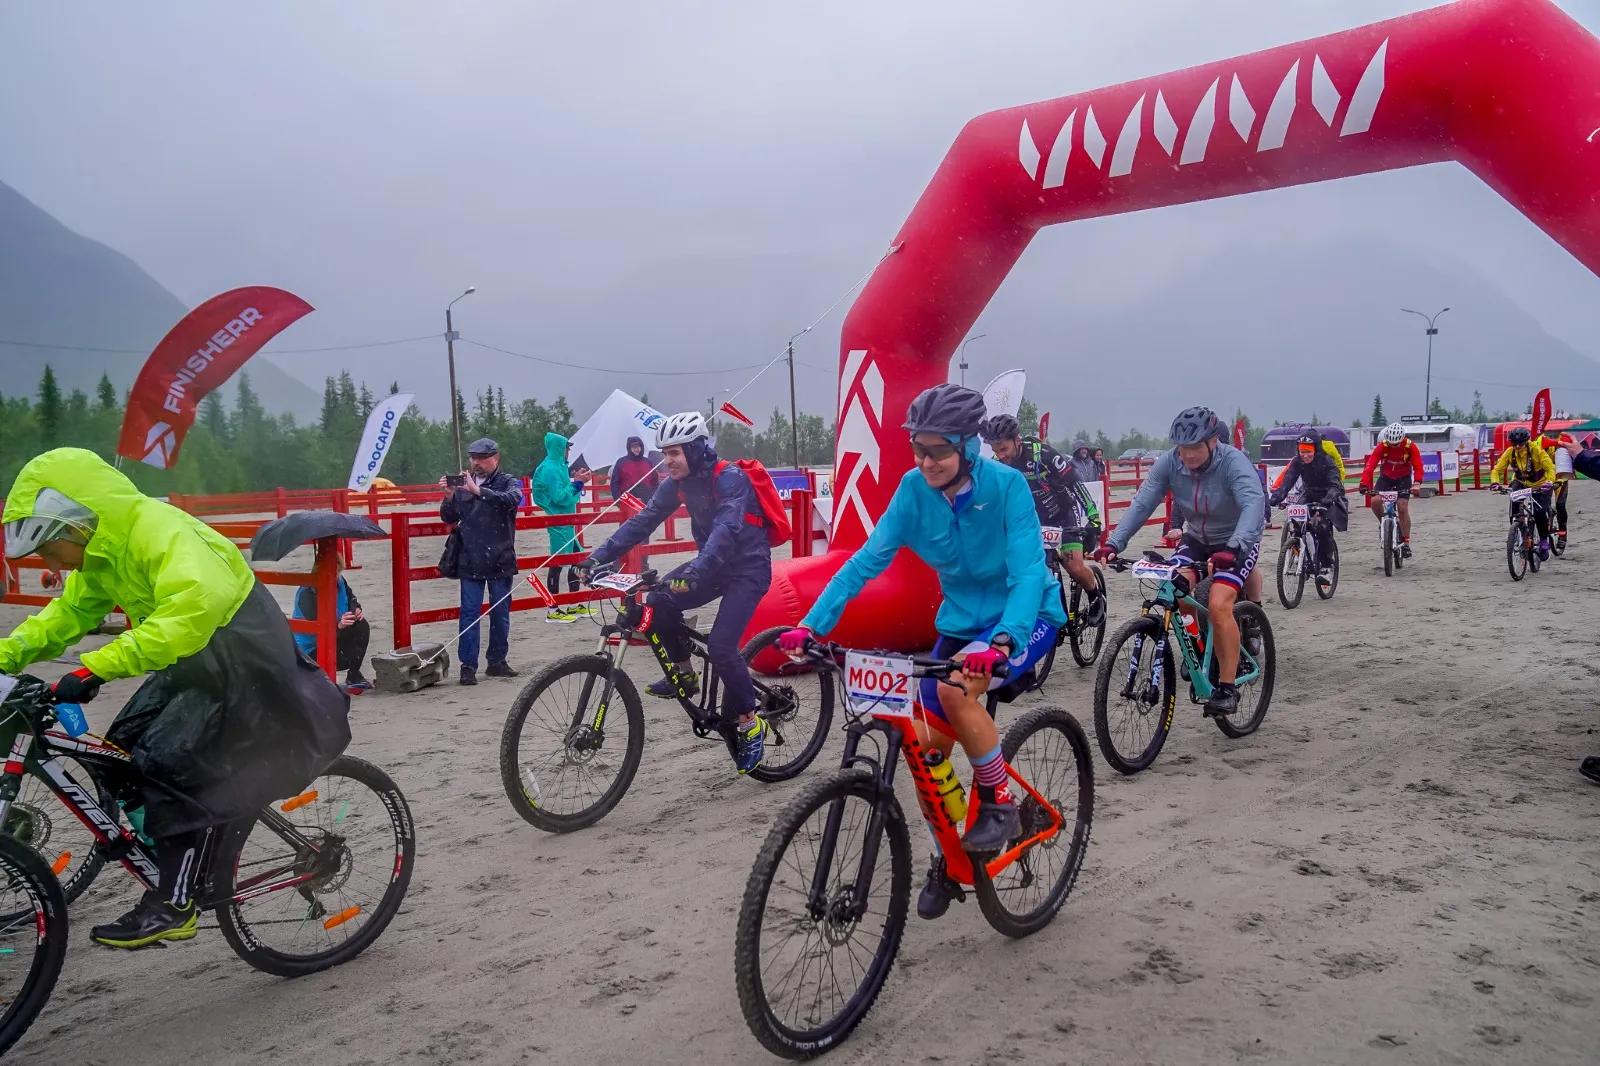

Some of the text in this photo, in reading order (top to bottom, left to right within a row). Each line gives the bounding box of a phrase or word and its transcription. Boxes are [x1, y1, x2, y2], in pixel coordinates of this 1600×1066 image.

[163, 306, 264, 415] FINISHERR
[367, 410, 395, 472] ФОСАГРО
[1240, 542, 1260, 579] BORA
[849, 666, 908, 694] M002
[389, 789, 411, 840] MERIDA
